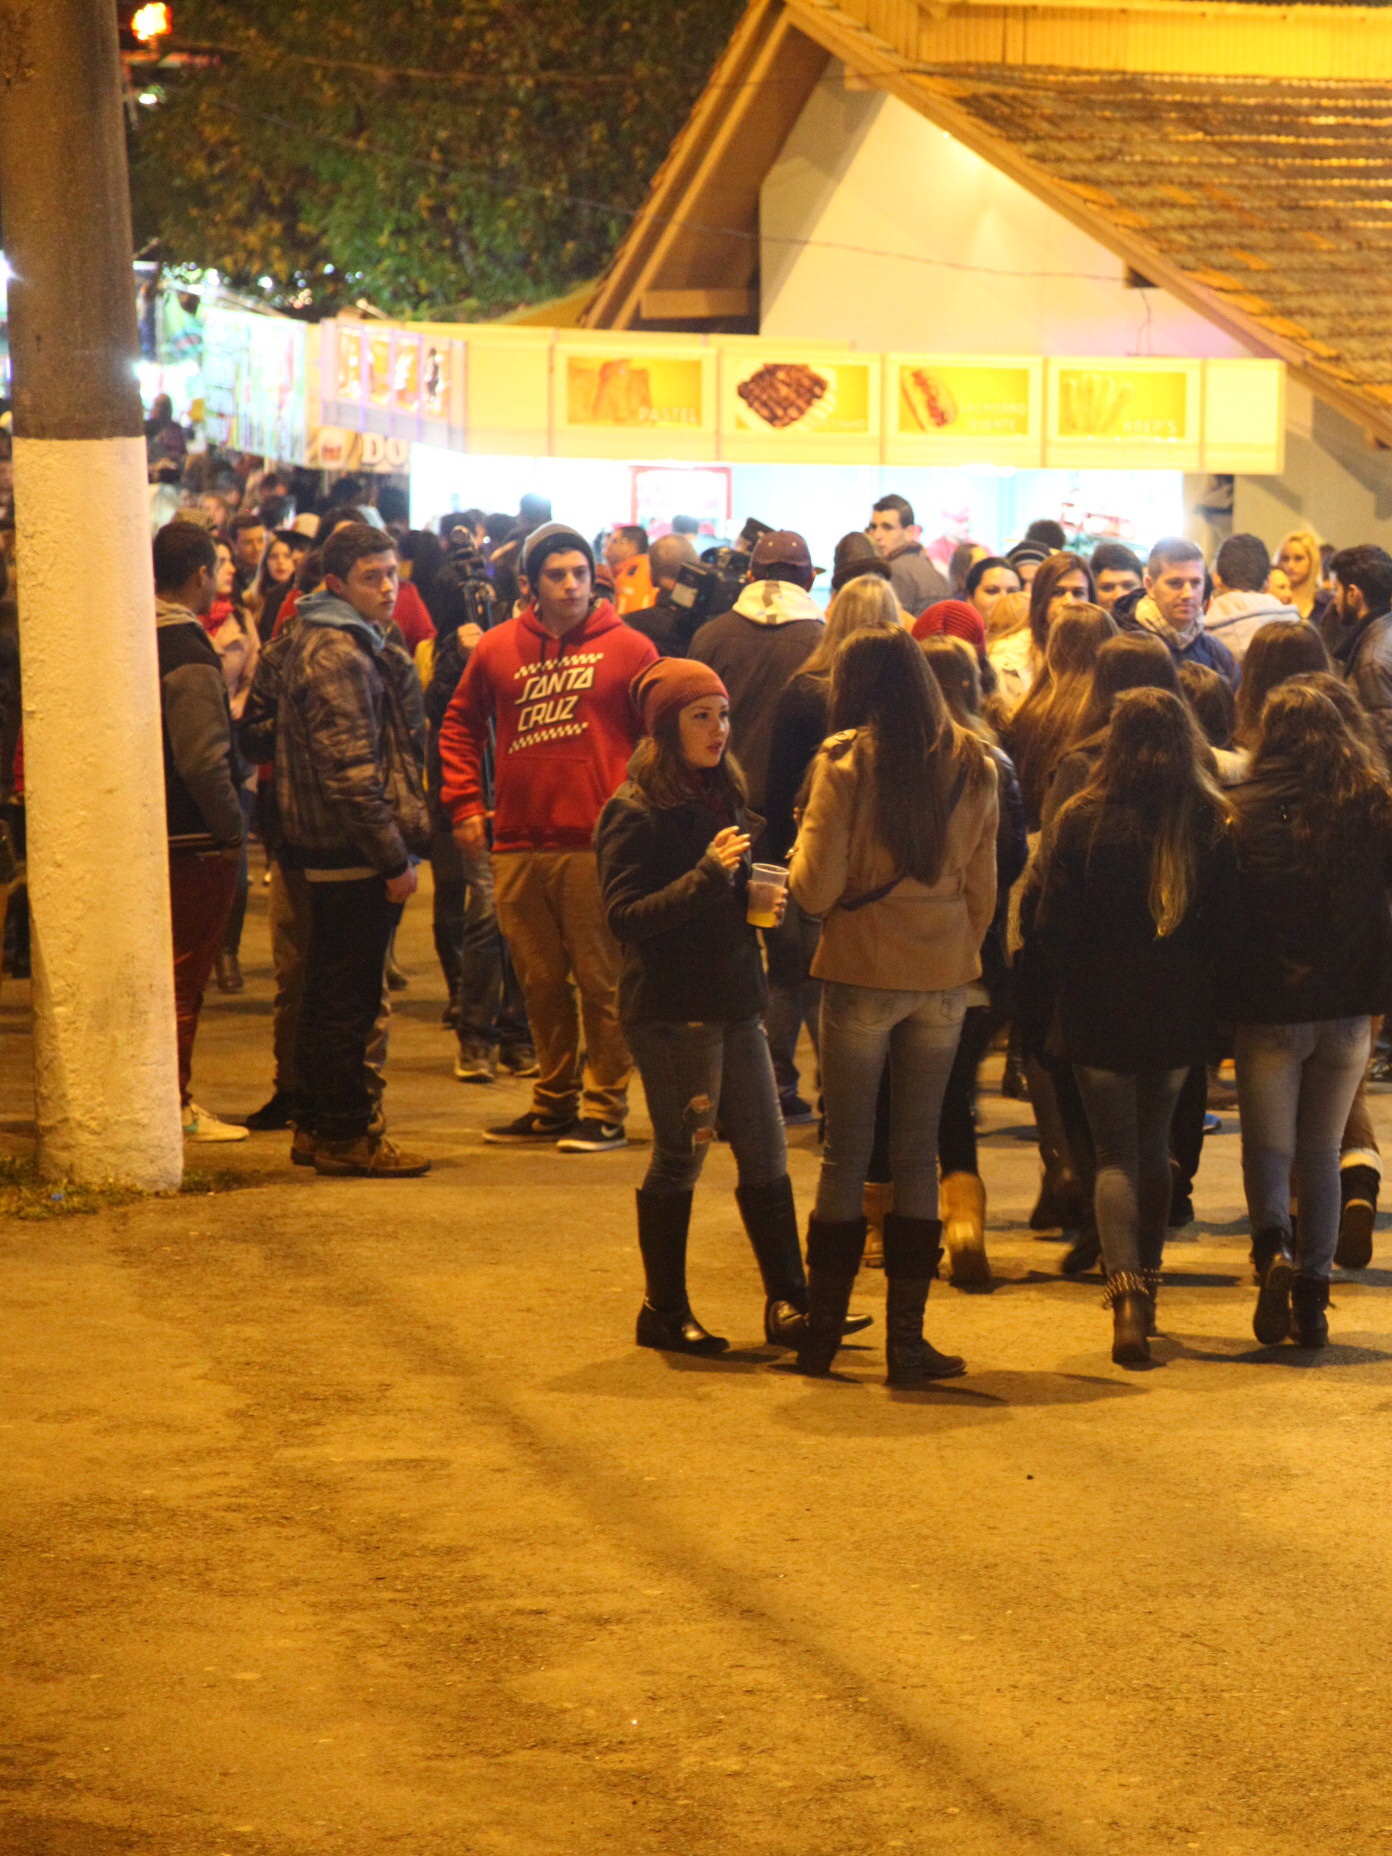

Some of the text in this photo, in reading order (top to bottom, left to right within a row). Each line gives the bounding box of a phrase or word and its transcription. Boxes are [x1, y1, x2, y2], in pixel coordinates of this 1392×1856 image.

[638, 405, 698, 424] PASTEL
[1123, 419, 1178, 435] KREP'S
[515, 666, 595, 705] SANTA
[518, 695, 580, 733] CRUZ
